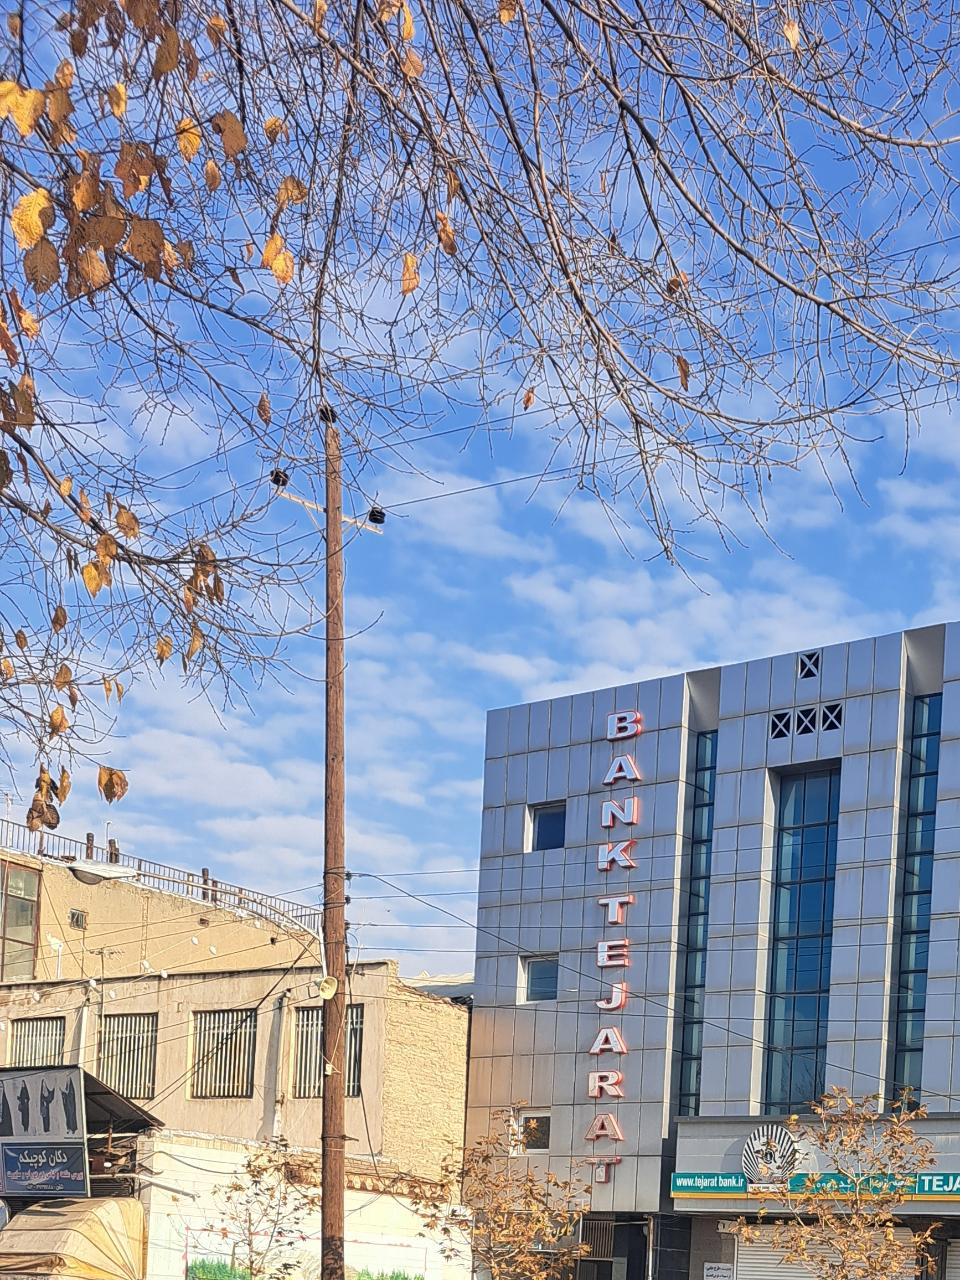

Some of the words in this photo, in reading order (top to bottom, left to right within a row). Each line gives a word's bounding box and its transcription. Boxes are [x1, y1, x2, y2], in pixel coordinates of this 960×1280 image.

[597, 710, 643, 872] BANK
[583, 894, 636, 1184] TEJARAT
[48, 1149, 68, 1167] دکان
[719, 1175, 744, 1187] bank.ir
